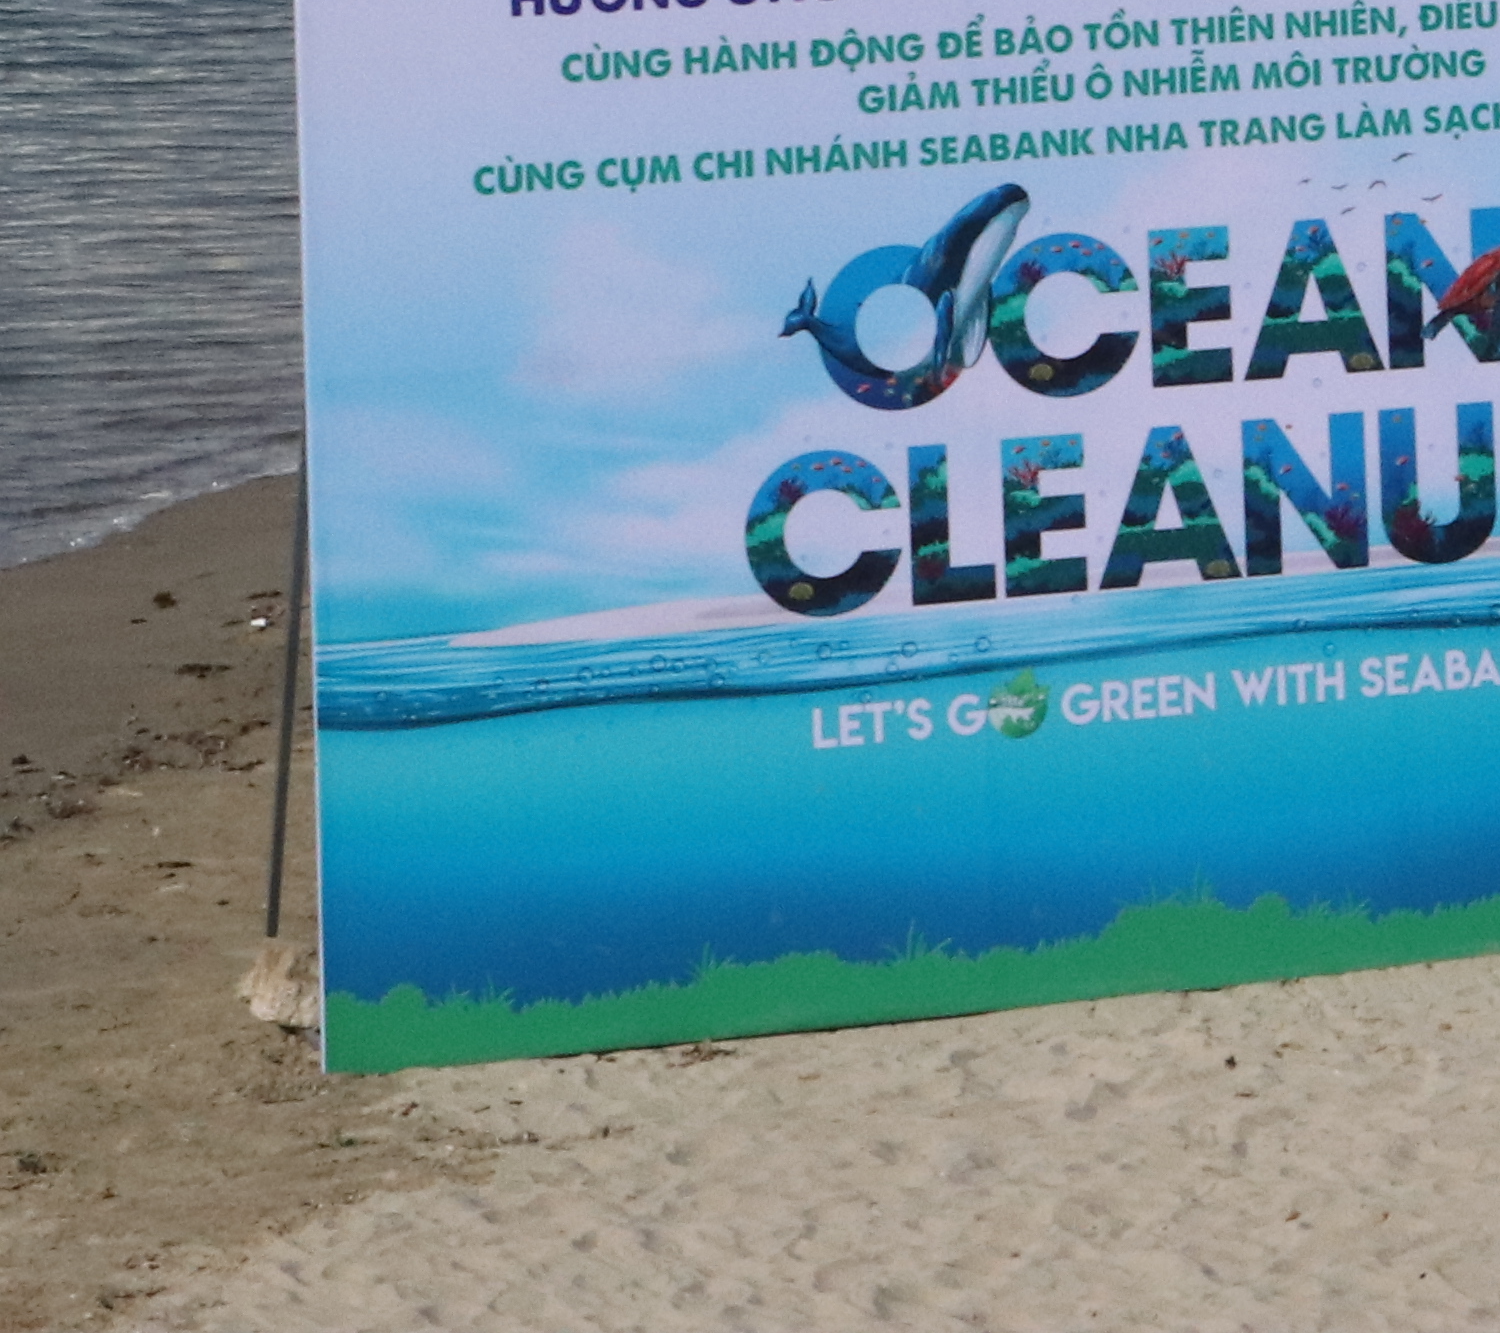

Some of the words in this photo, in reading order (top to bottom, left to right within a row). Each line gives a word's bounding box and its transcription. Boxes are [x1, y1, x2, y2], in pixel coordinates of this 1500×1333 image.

[561, 41, 672, 83] CÙNG
[683, 36, 797, 75] HÀNH
[809, 28, 925, 73] ĐỘNG
[936, 13, 985, 60] ĐỂ
[994, 15, 1074, 56] BẢO
[1082, 8, 1160, 51] TỒN
[1170, 5, 1275, 47] THIÊN
[857, 71, 960, 115] GIẢM
[970, 58, 1075, 107] THIỂU
[1084, 62, 1114, 100] Ô
[1123, 48, 1241, 98] NHIỄM
[1252, 50, 1322, 90] MÔI
[1331, 44, 1486, 85] TRƯỜNG
[474, 154, 587, 196] CÙNG
[596, 151, 682, 193] CỤM
[692, 149, 755, 182] CHI
[765, 134, 908, 176] NHÁNH
[919, 127, 1095, 167] SEABANK
[1106, 121, 1189, 154] NHA
[1198, 112, 1326, 147] TRANG
[1336, 101, 1413, 140] LÀM
[811, 692, 933, 751] LET'S
[1061, 673, 1218, 726] GREEN
[1231, 659, 1347, 708] WITH
